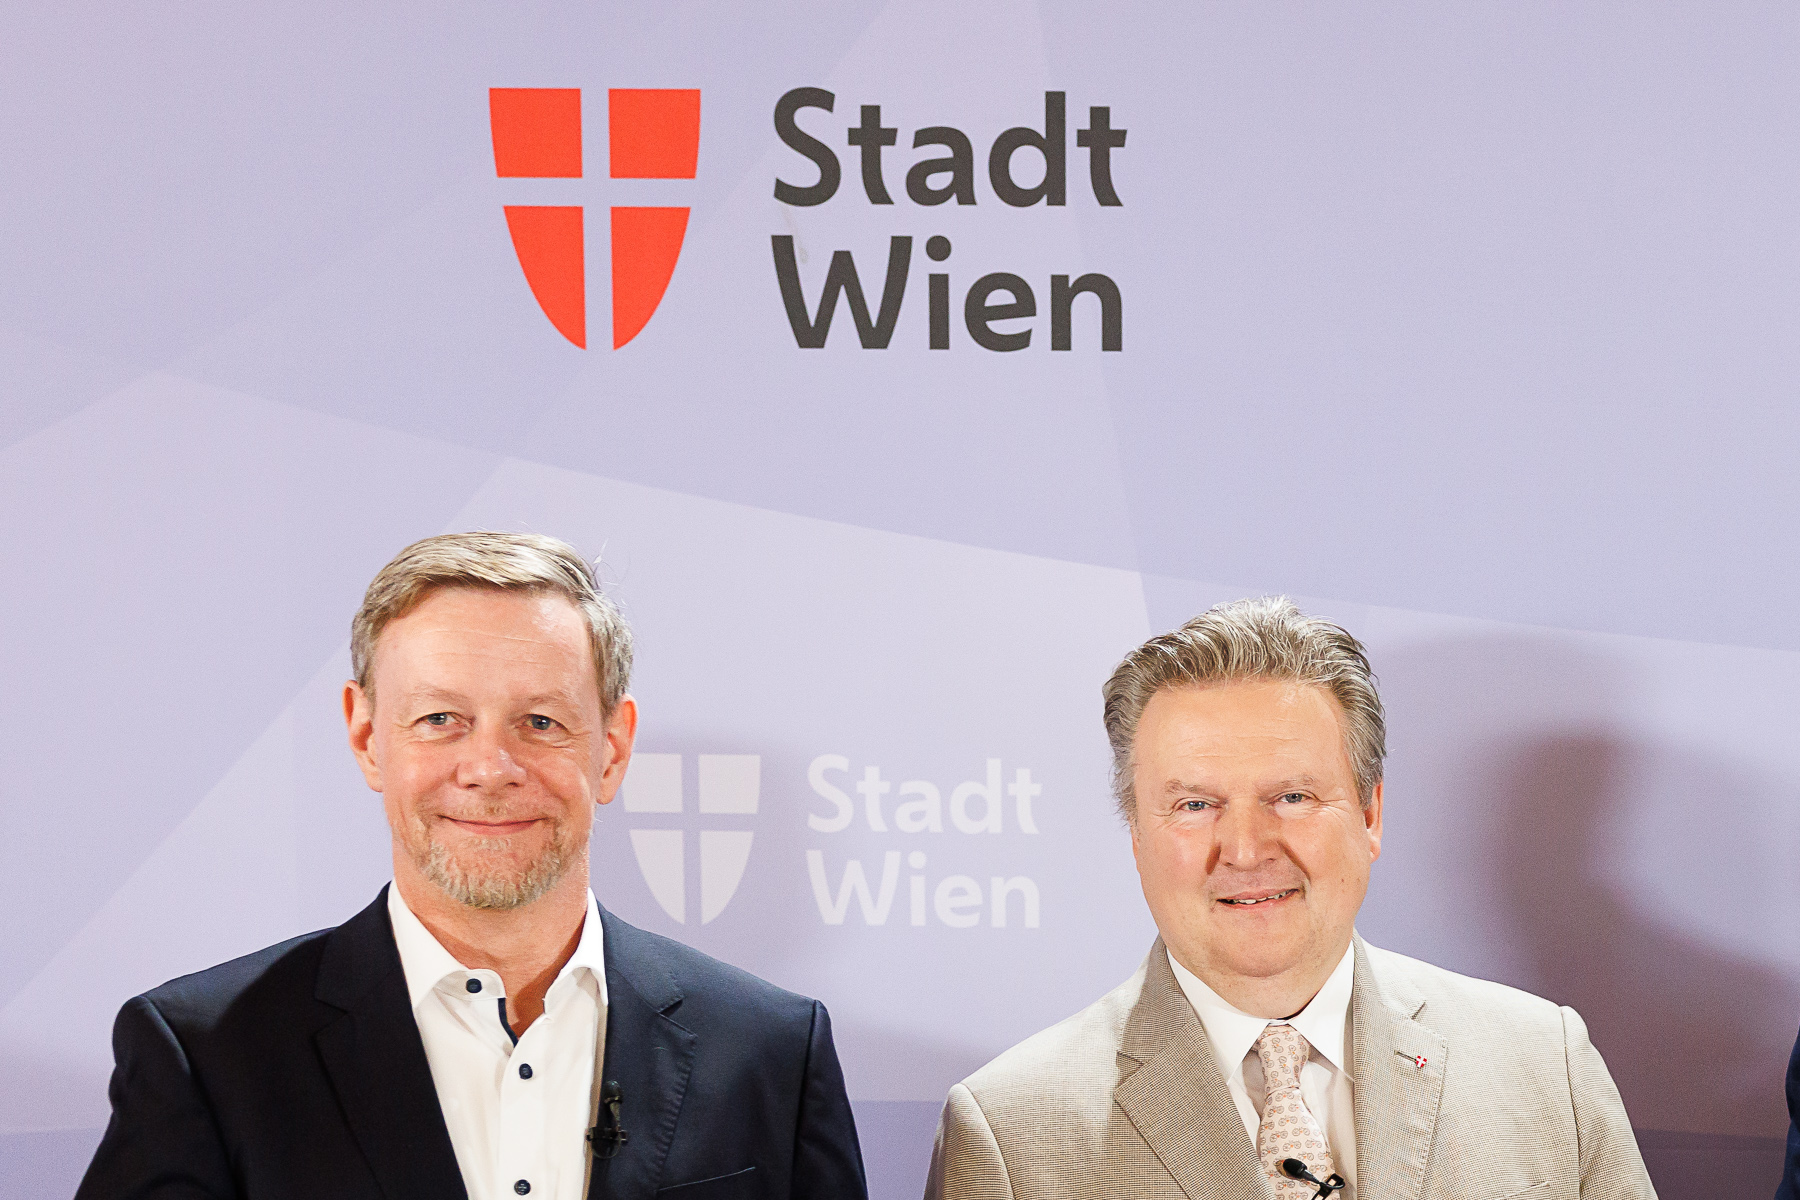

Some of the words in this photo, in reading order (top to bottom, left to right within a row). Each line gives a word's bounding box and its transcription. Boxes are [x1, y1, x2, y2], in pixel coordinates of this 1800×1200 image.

[773, 86, 1128, 208] Stadt
[770, 234, 1123, 353] Wien
[806, 753, 1043, 835] Stadt
[805, 849, 1041, 929] Wien
